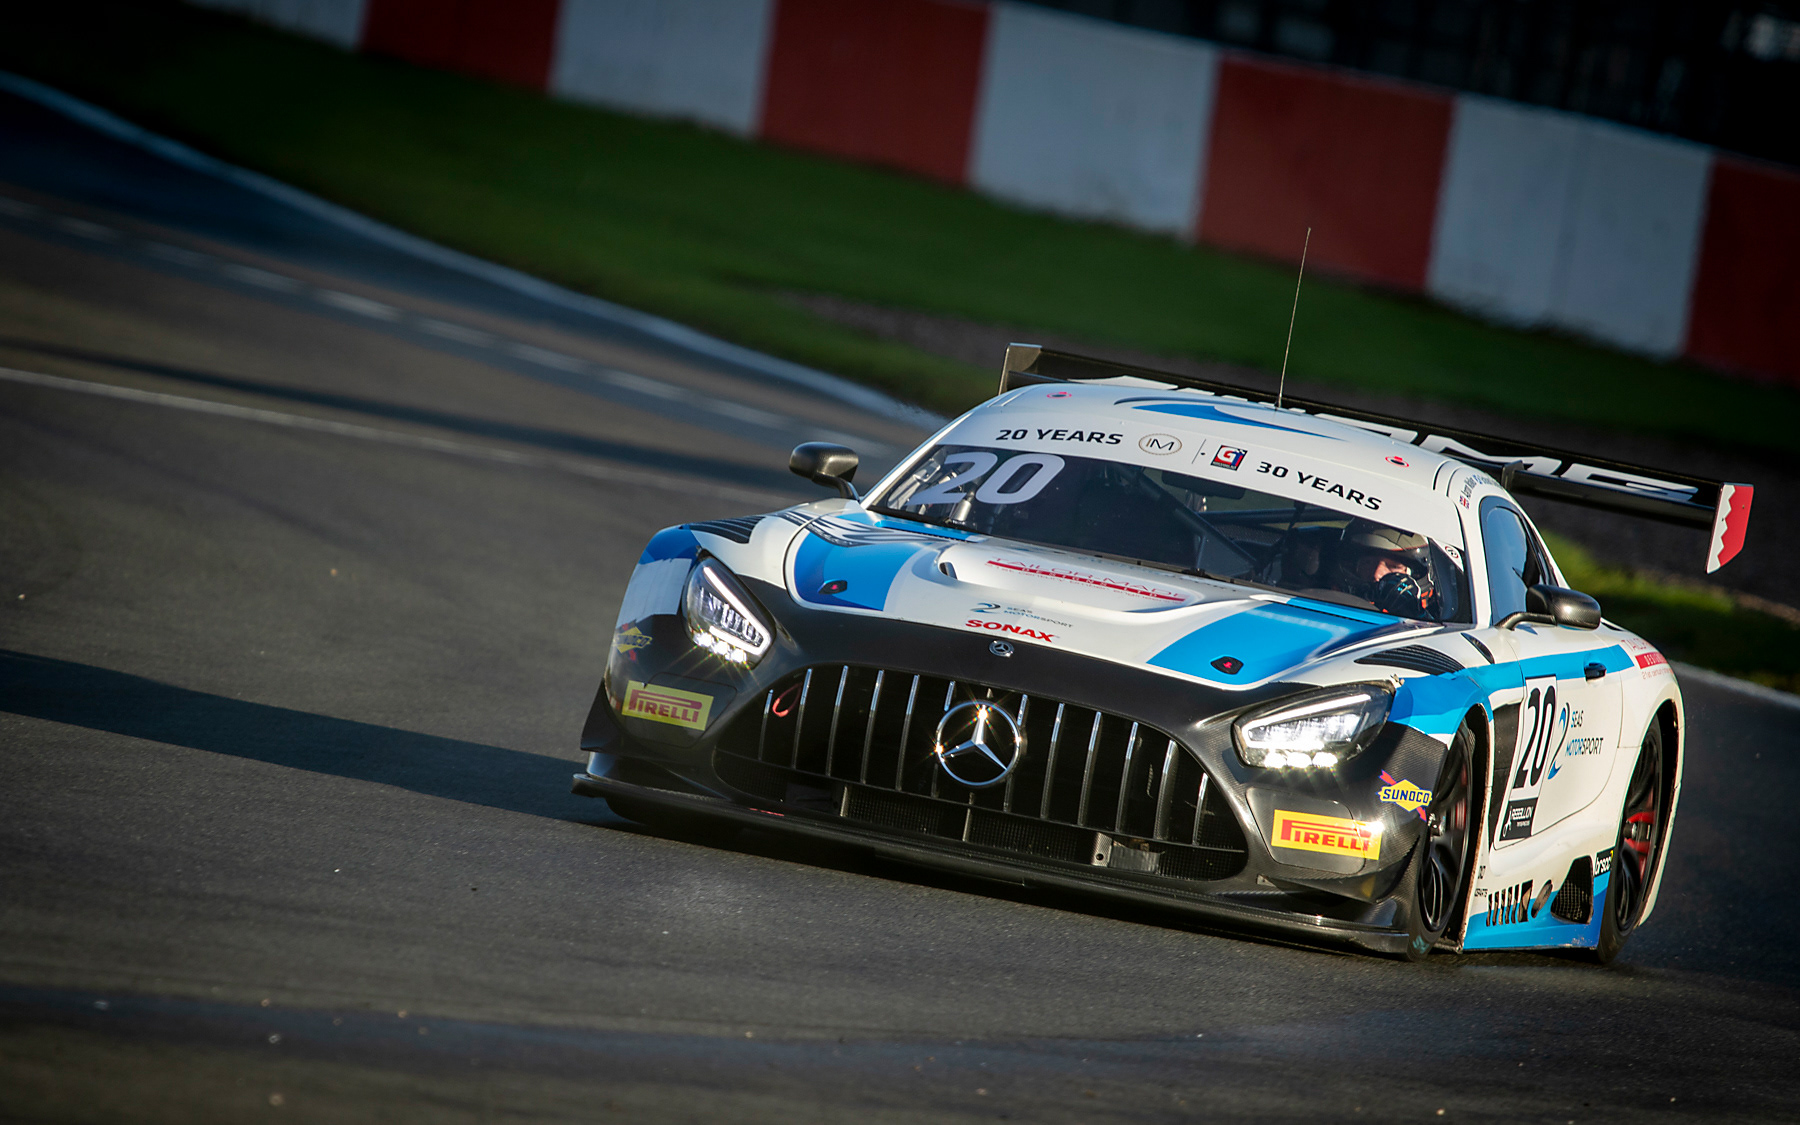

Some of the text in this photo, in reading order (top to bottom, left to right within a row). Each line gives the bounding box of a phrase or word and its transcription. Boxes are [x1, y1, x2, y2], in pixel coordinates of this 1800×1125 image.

[996, 429, 1124, 445] 20 YEARS
[906, 452, 1067, 504] 20
[1256, 461, 1383, 511] 30 YEARS
[965, 619, 1055, 643] SONAX
[628, 689, 703, 723] PIRELLI
[1513, 685, 1556, 789] 20
[1565, 737, 1604, 757] MOTORSPORT
[1383, 788, 1430, 804] SUNOCO
[1280, 819, 1373, 852] PIRELLI
